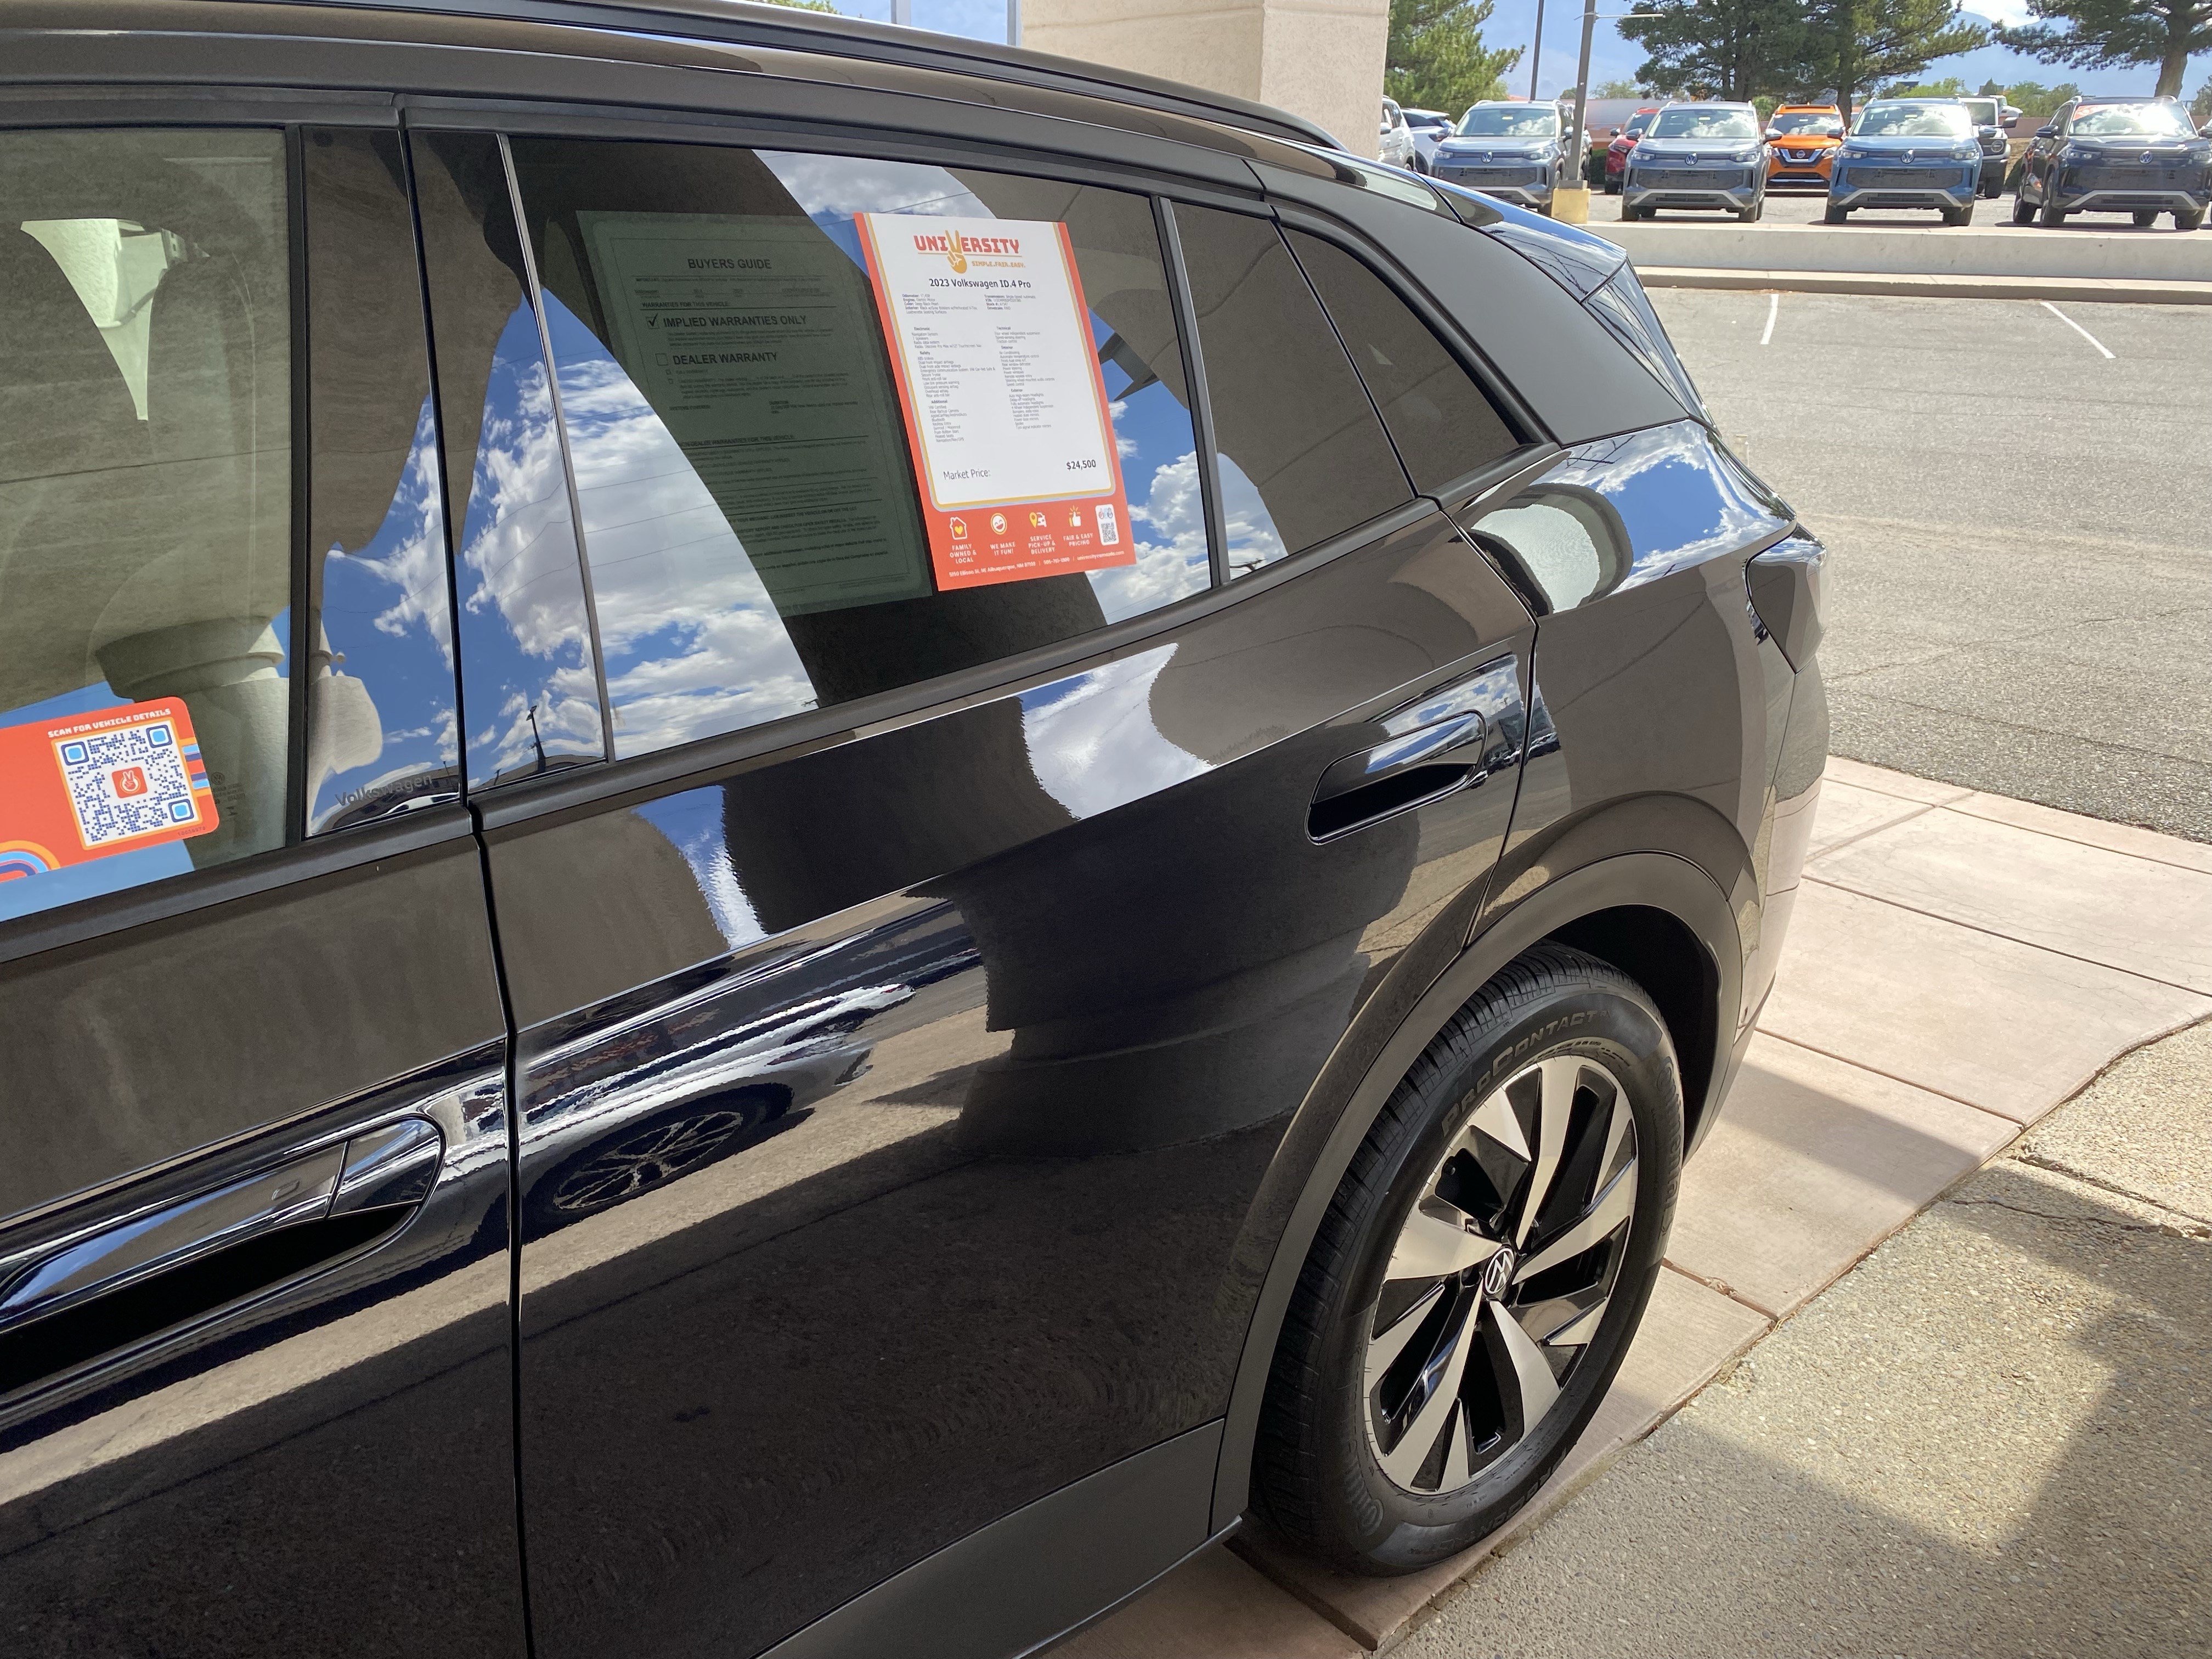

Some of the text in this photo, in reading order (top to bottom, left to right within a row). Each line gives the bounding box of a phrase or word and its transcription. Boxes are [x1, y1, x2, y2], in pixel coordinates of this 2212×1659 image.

[687, 258, 772, 269] BUYERS GUIDE
[929, 279, 950, 287] 2023
[951, 279, 998, 289] Volkswagen
[999, 280, 1017, 288] ID.4
[663, 315, 806, 328] IMPLIED WARRANTIES ONLY
[672, 352, 777, 365] DEALER WARRANTY
[1066, 459, 1096, 471] $24,500
[943, 468, 991, 480] Market Price:
[1030, 534, 1052, 542] SERVICE
[950, 550, 971, 558] OWNED
[1030, 546, 1056, 555] DELIVERY
[48, 708, 171, 738] SCAN FOR VEHICLE DETAILS
[334, 774, 432, 806] Volkswagen
